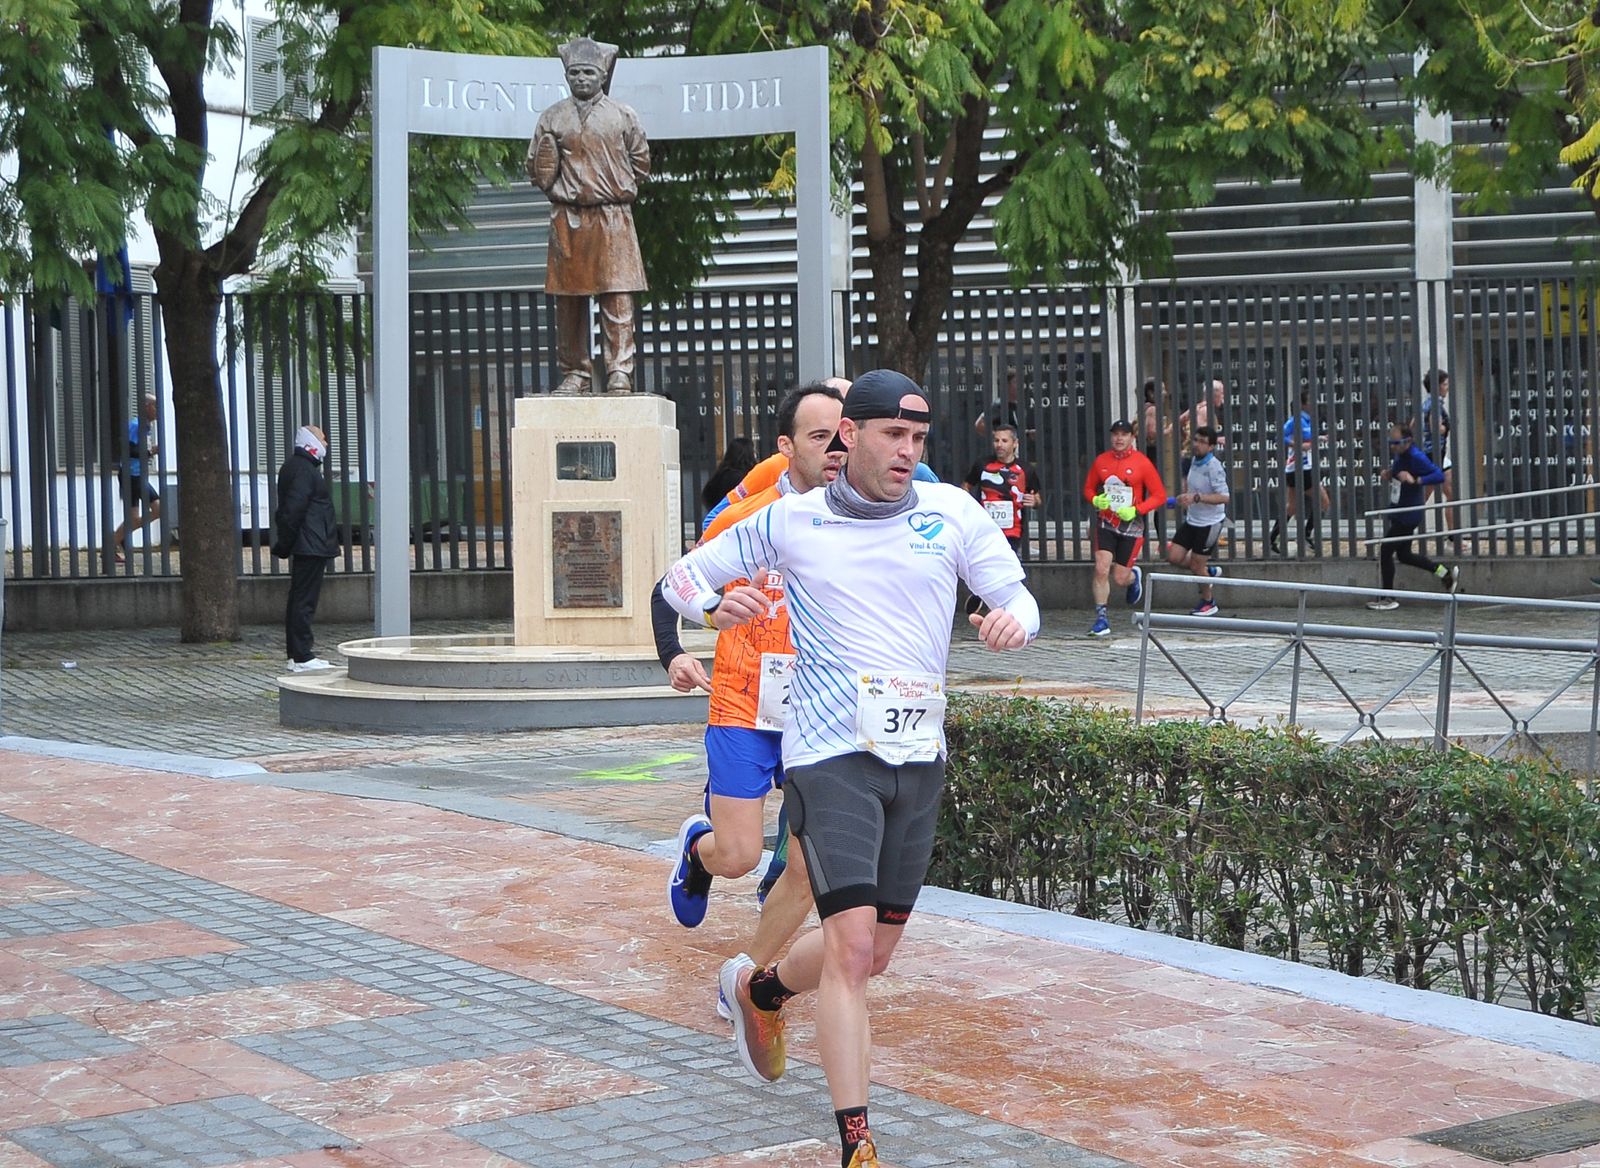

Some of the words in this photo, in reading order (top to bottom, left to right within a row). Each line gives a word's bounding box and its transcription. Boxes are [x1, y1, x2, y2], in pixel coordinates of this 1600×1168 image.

[680, 77, 783, 113] FIDEI
[1111, 494, 1126, 504] 955
[991, 510, 1007, 519] 170
[484, 667, 529, 684] DEL
[545, 665, 653, 684] SANTERO
[883, 707, 928, 734] 377
